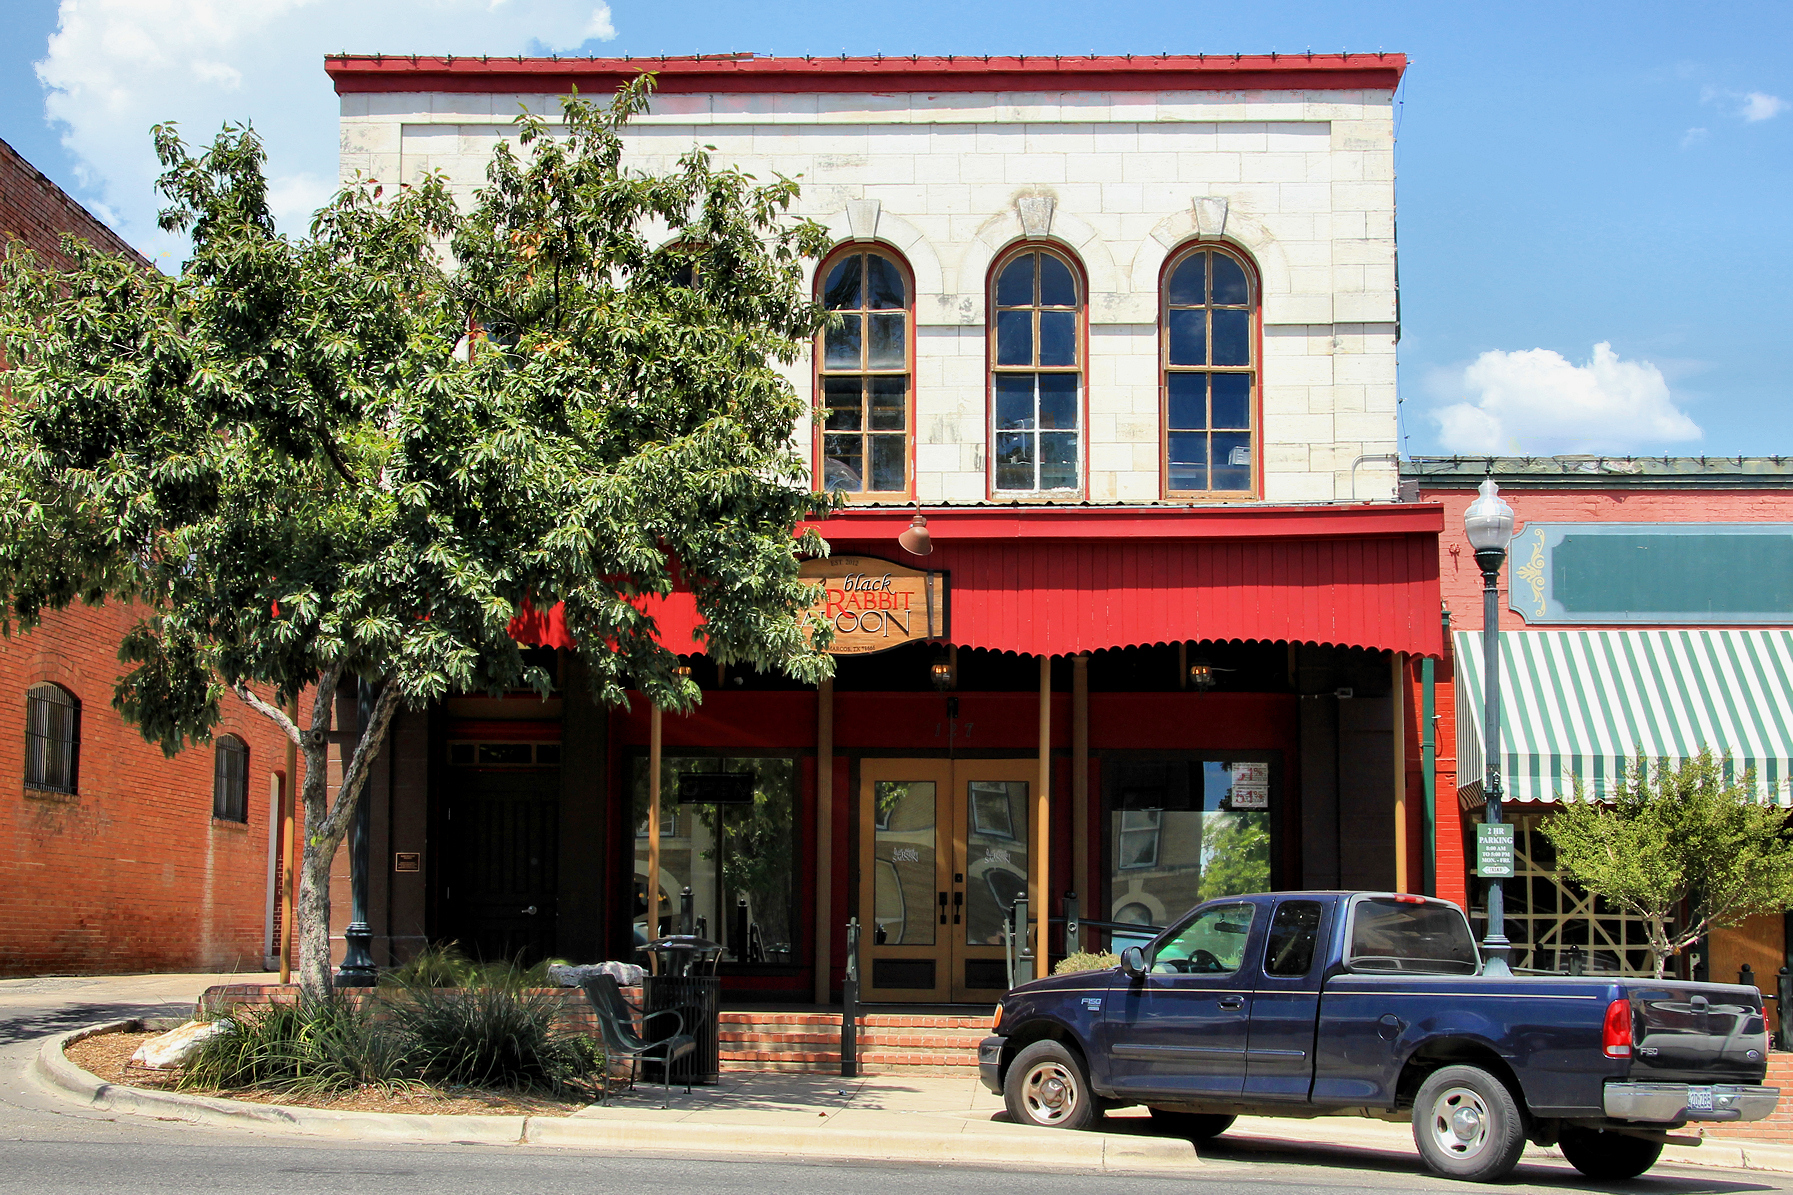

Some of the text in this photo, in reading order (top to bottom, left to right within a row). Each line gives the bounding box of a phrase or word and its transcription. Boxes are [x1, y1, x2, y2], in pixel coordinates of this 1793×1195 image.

[843, 573, 896, 595] black
[825, 588, 915, 618] RABBIT
[1640, 1047, 1659, 1056] F150
